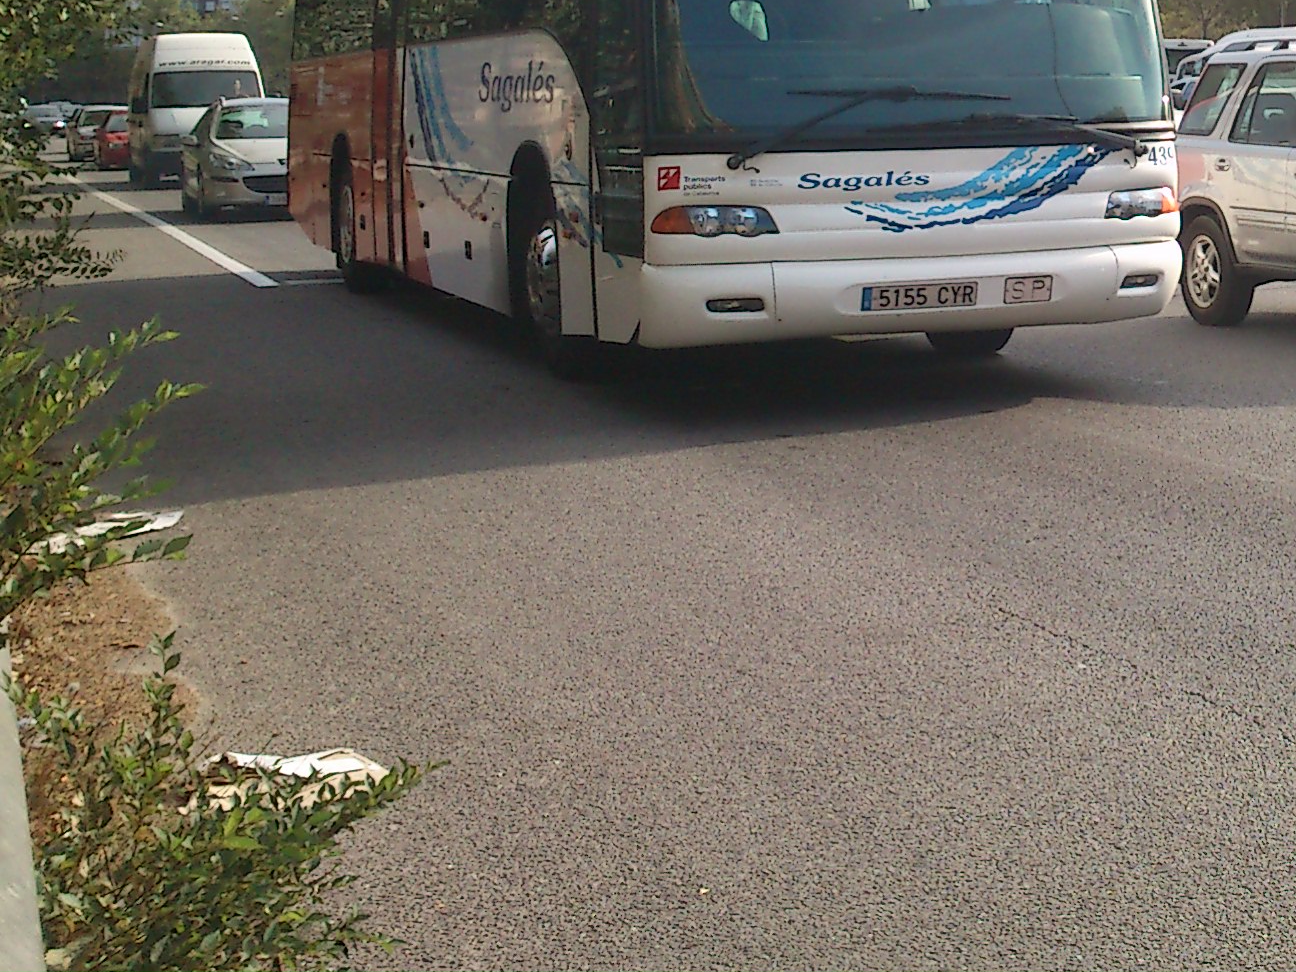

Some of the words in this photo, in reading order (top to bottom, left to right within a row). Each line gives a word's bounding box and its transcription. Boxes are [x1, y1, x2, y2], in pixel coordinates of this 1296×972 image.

[478, 59, 555, 113] Sagalés
[797, 170, 930, 192] Sagalés
[879, 287, 928, 307] 5155
[937, 285, 974, 304] CYR
